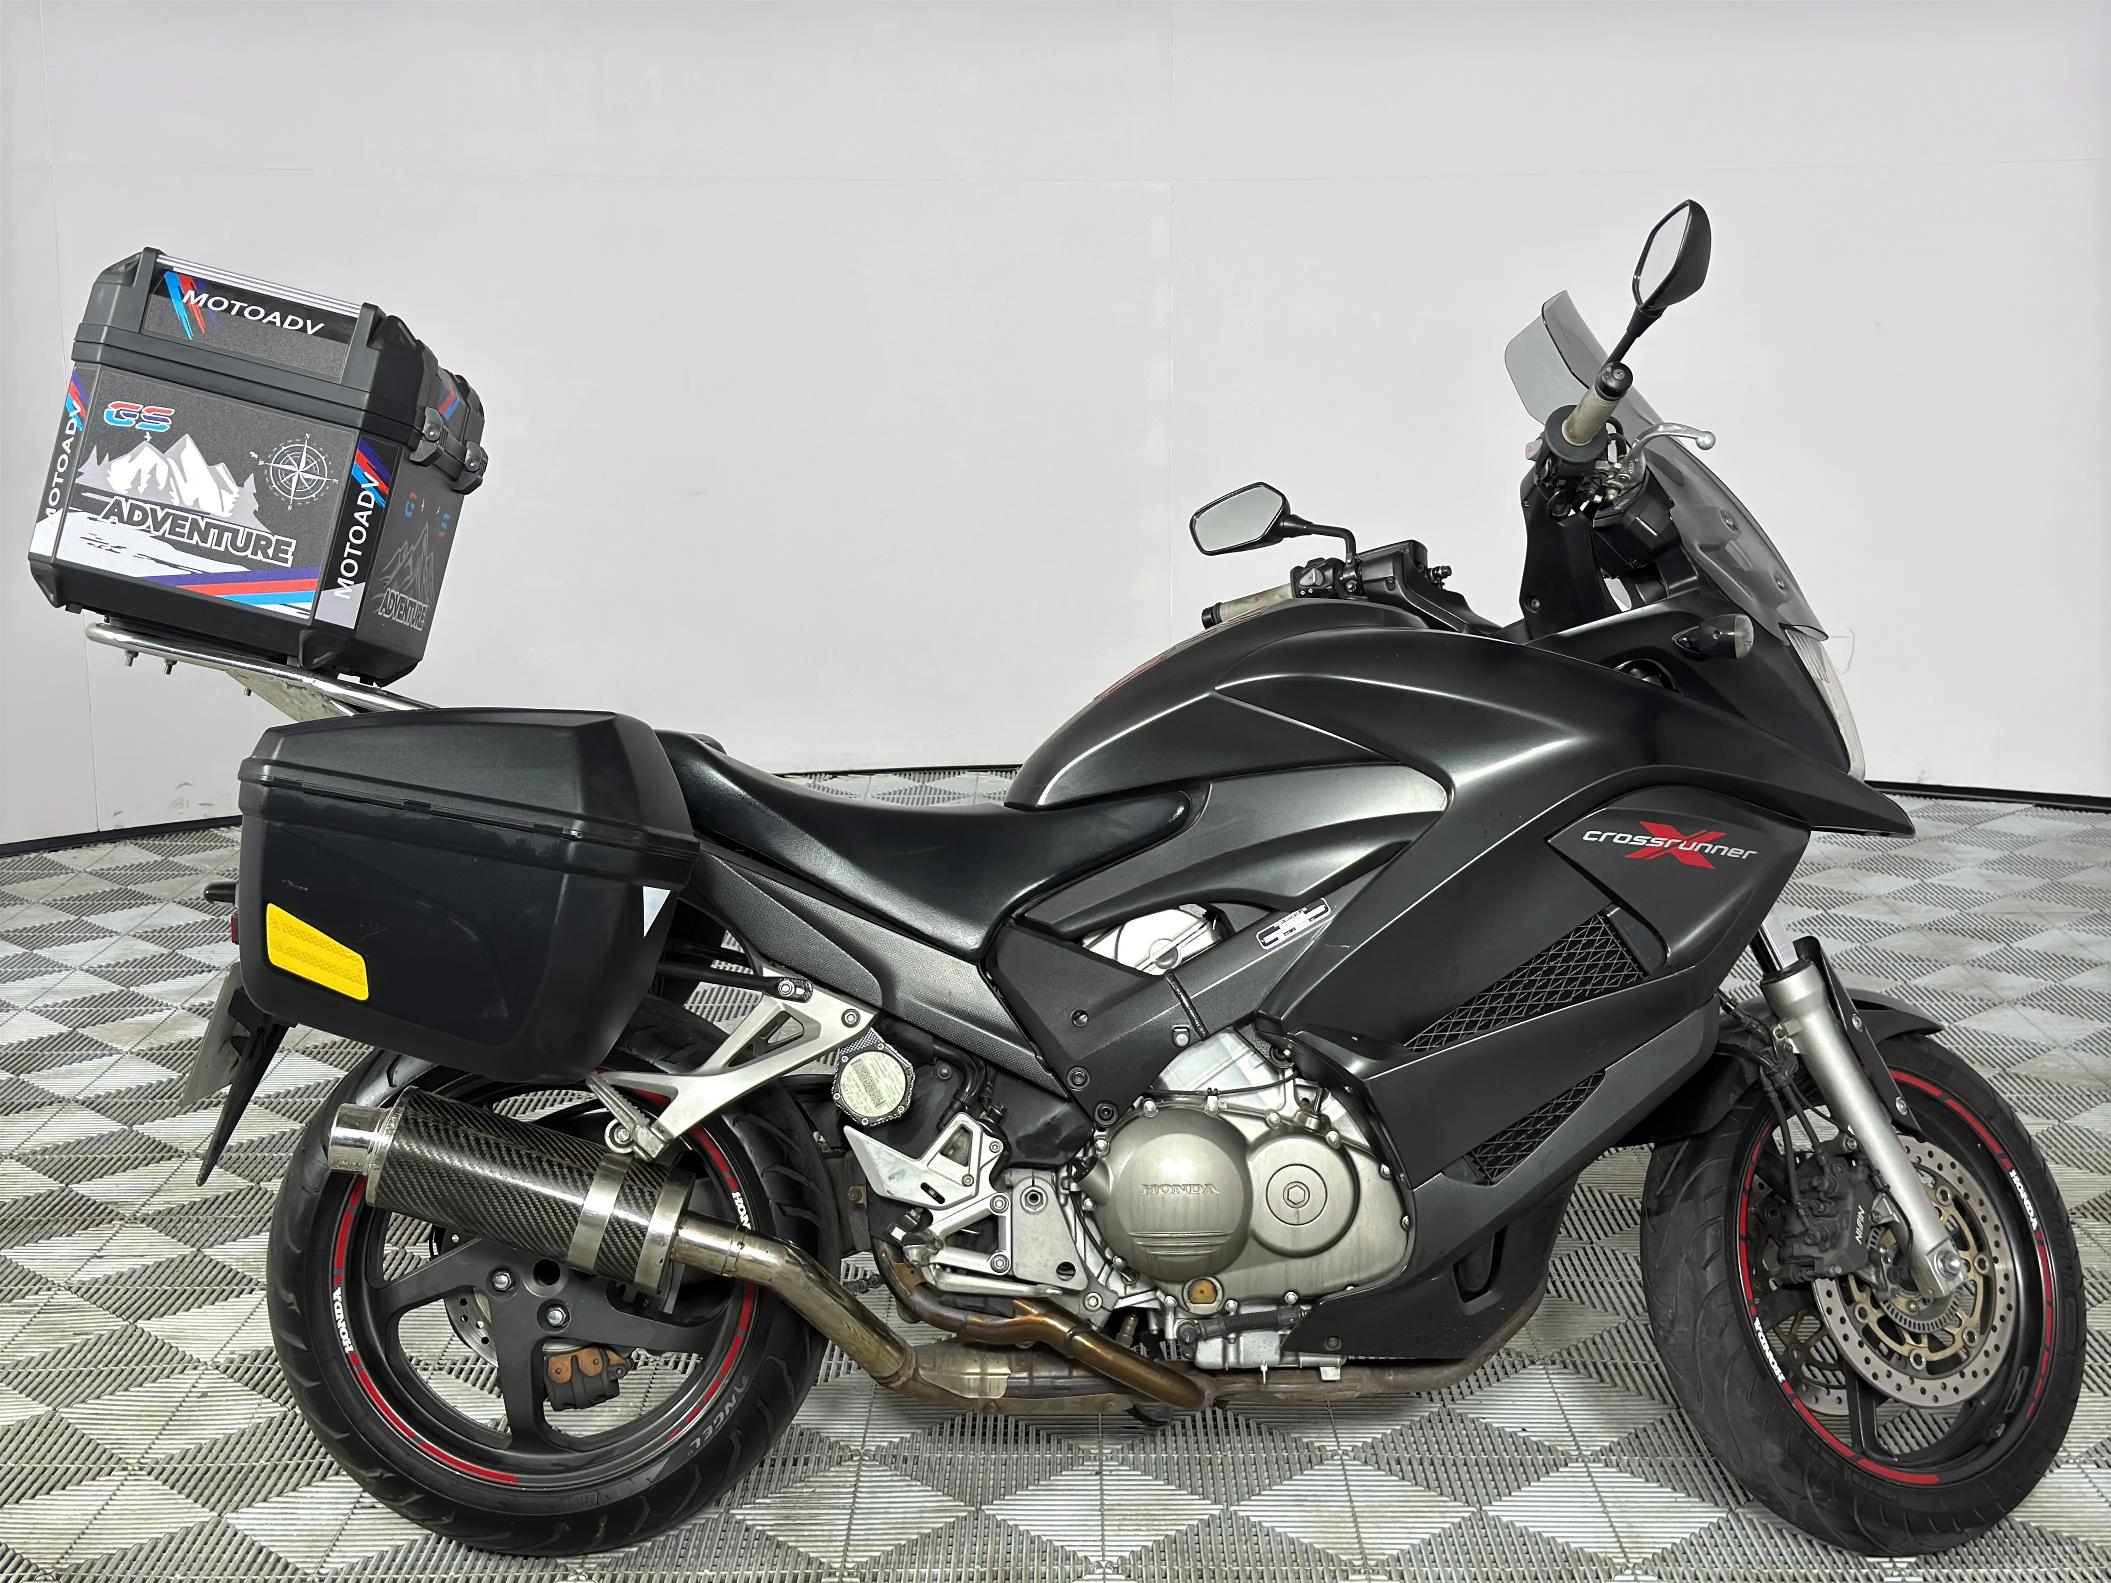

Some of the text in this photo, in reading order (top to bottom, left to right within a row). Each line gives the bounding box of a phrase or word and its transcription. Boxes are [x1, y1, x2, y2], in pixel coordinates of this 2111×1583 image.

[182, 289, 325, 335] MOTOADV
[103, 400, 175, 432] GS
[100, 496, 297, 567] ADVENTURE
[334, 471, 381, 600] MOTOADV
[378, 588, 428, 631] ADVENTURE
[1582, 830, 1760, 860] crossrunner
[731, 1191, 752, 1230] HON
[1139, 1183, 1220, 1195] HONDA
[2009, 1169, 2038, 1231] HONDA
[332, 1286, 354, 1354] HONDA
[1754, 1316, 1786, 1383] HONDA
